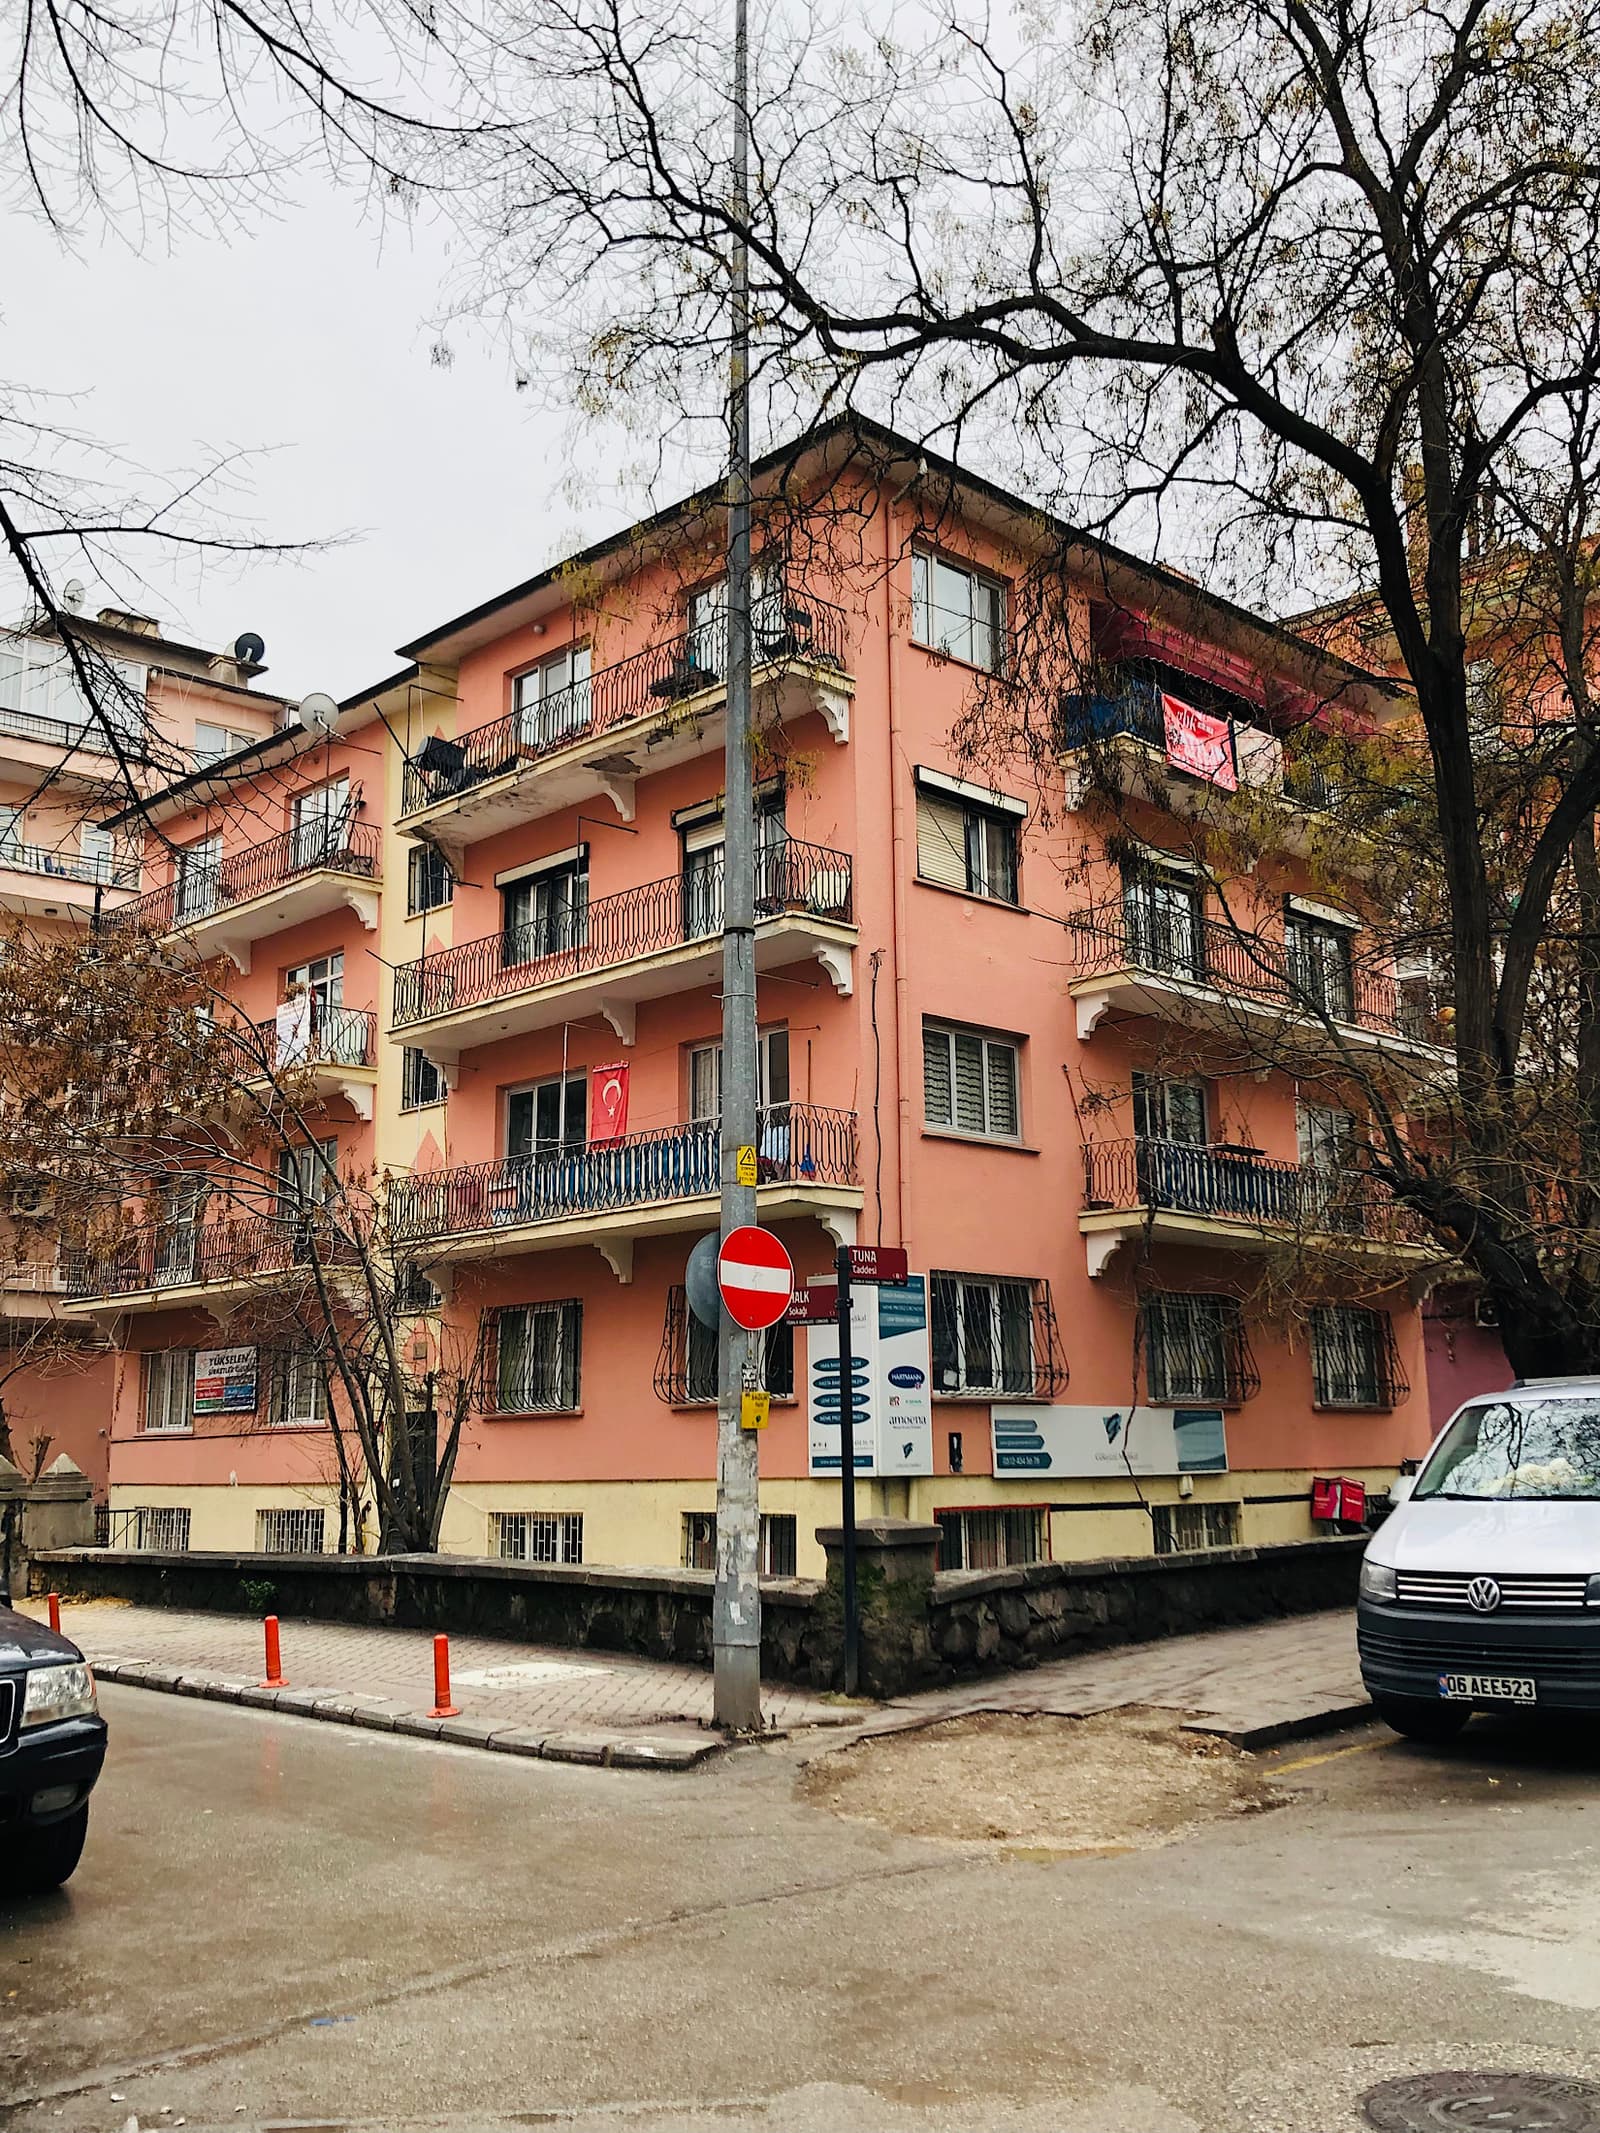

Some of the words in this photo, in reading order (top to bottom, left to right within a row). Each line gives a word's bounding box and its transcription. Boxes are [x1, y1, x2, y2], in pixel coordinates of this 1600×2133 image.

[852, 1249, 877, 1263] TUNA
[852, 1265, 877, 1275] Caddesi
[891, 1373, 922, 1381] HARTMANN
[888, 1415, 928, 1425] amoena
[1447, 1676, 1467, 1693] 06
[1471, 1677, 1535, 1698] AEE523
